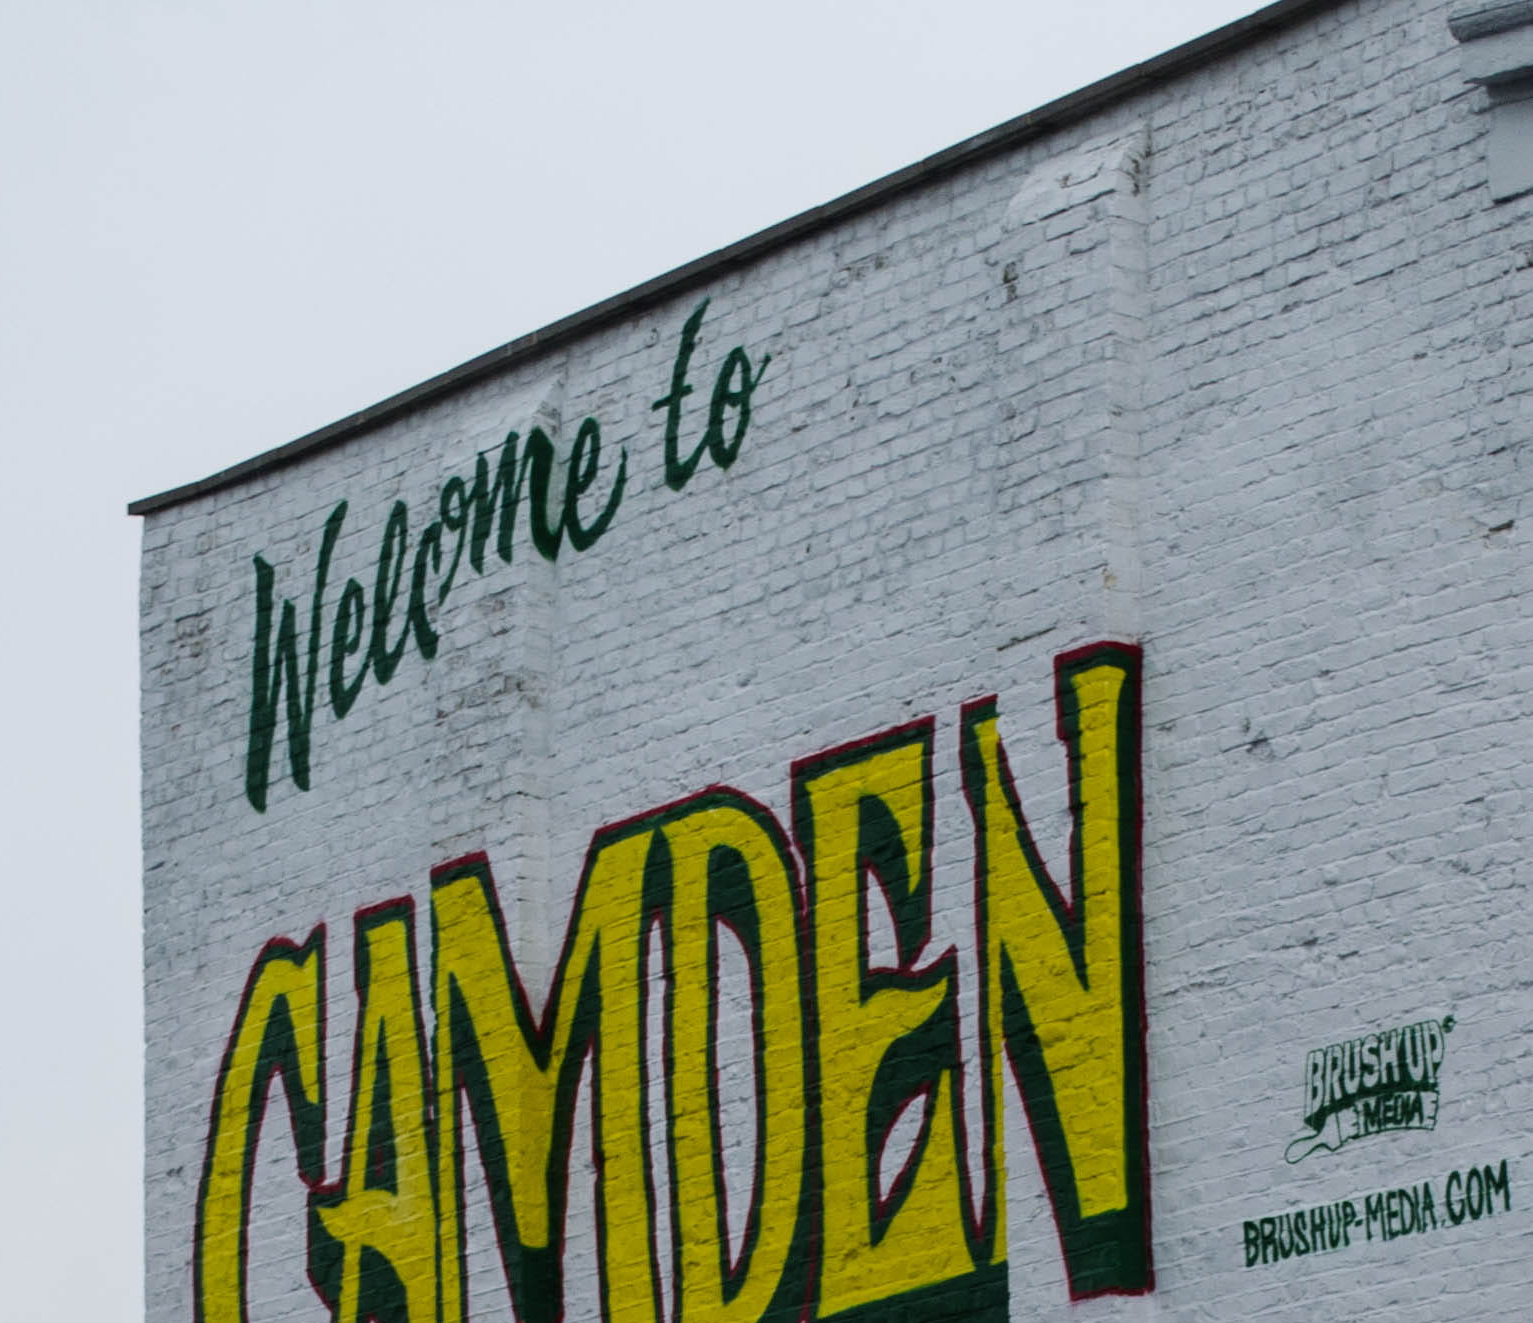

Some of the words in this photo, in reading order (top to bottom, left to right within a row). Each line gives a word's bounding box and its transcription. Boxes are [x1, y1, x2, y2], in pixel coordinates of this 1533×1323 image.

[246, 417, 628, 813] Welcome
[652, 297, 772, 491] to
[1362, 1093, 1423, 1130] MEDIA
[1243, 1159, 1511, 1267] BRUSHUP-MEDIA.COM
